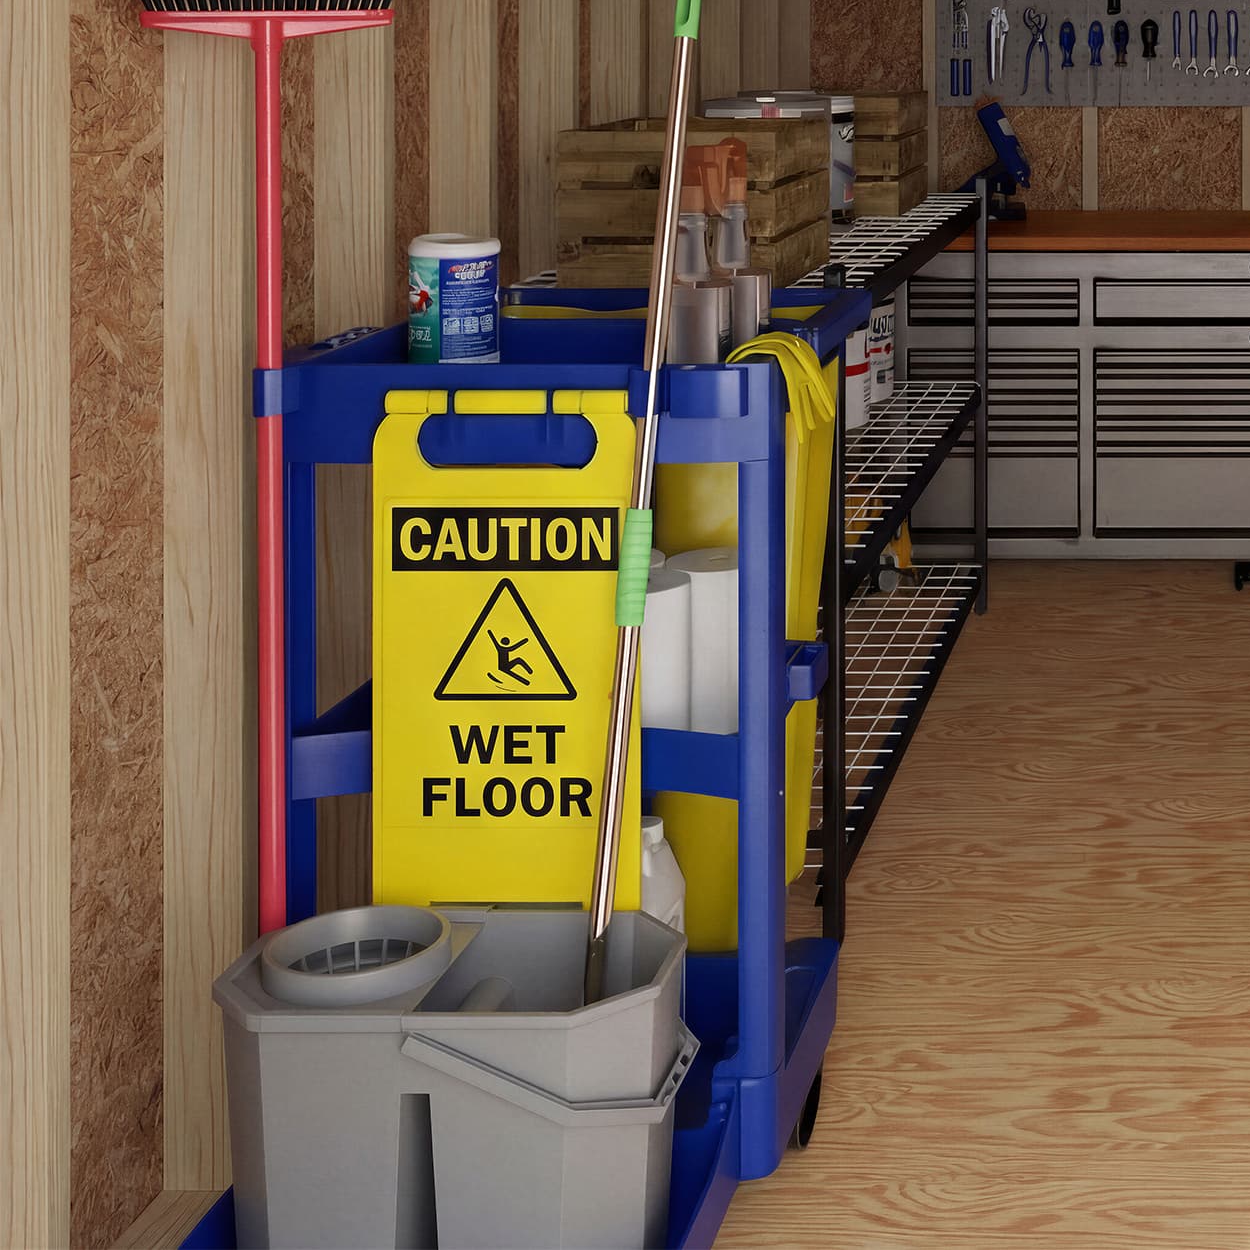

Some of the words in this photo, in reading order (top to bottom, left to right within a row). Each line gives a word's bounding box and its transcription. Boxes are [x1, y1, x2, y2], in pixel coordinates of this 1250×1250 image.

[399, 517, 612, 561] CAUTION
[450, 725, 566, 765] WET
[422, 776, 593, 818] FLOOR
